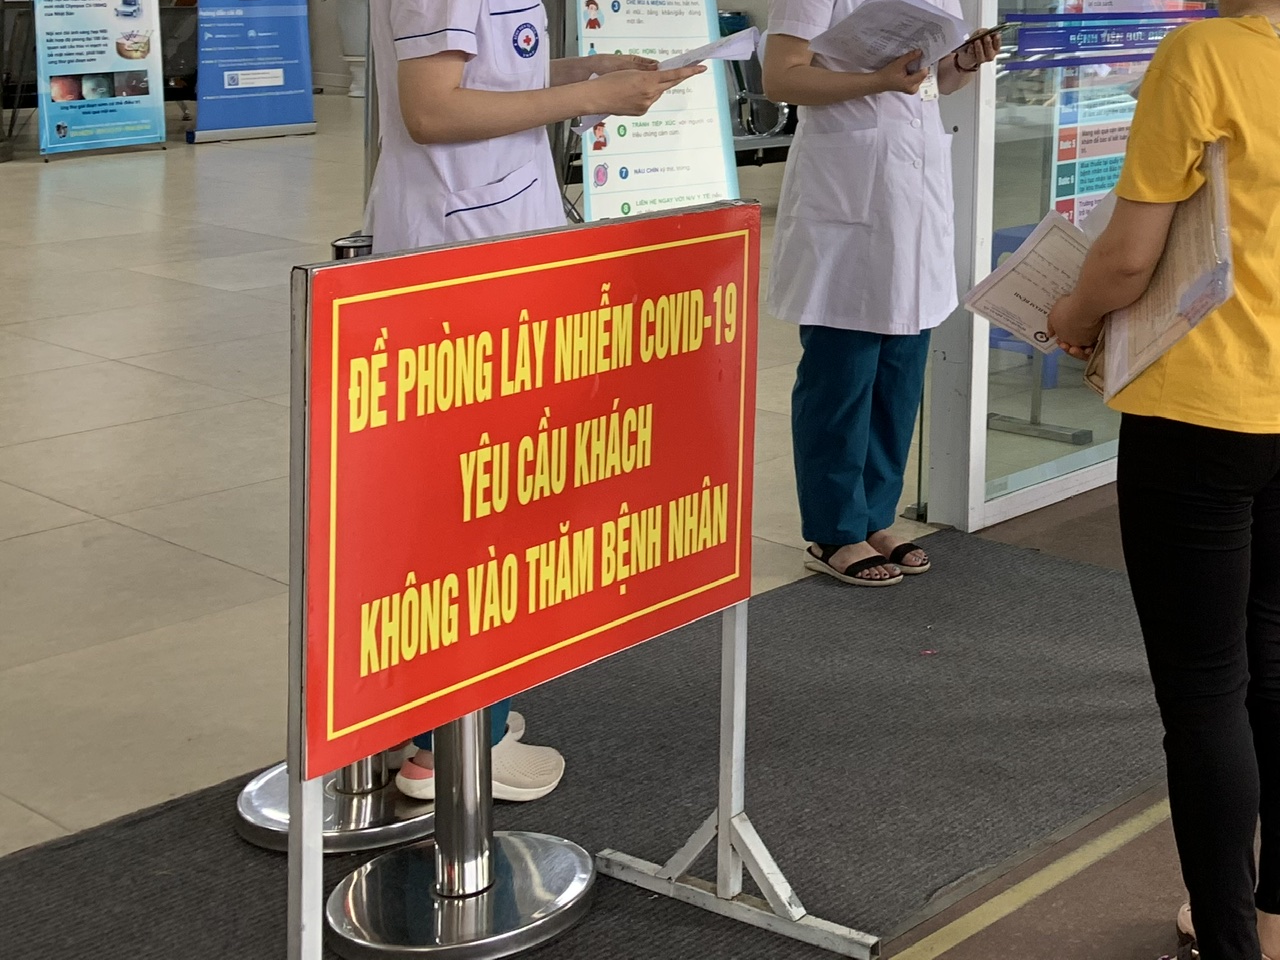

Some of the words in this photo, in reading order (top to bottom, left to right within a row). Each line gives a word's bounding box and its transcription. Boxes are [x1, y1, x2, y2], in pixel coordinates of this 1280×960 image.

[348, 327, 388, 433] ĐỀ
[397, 322, 492, 422] PHÒNG
[501, 309, 548, 397] LÂY
[554, 282, 633, 384] NHIỄM
[640, 282, 738, 363] COVID-19
[460, 432, 509, 523] YÊU
[517, 406, 566, 505] CẦU
[574, 398, 654, 488] KHÁCH
[360, 570, 459, 678] KHÔNG
[467, 546, 517, 636] VÀO
[526, 521, 594, 614] THĂM
[601, 502, 662, 595] BỆNH
[668, 475, 729, 557] NHÂN
